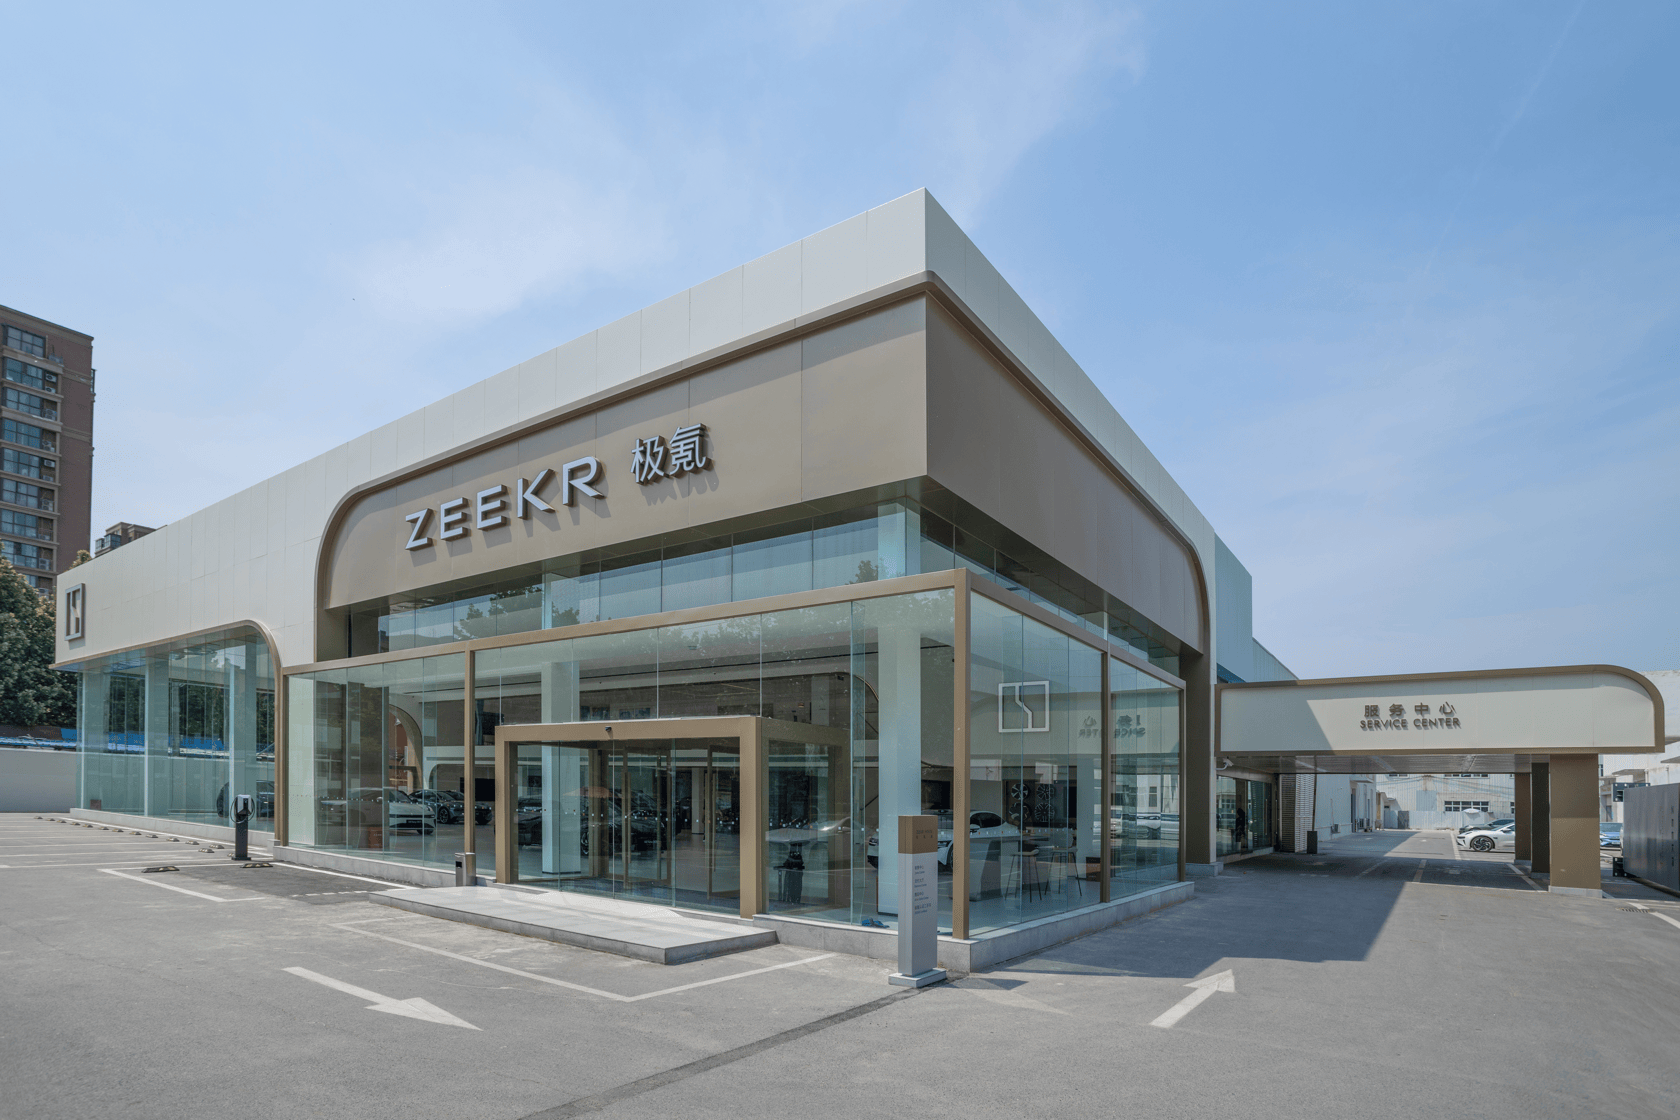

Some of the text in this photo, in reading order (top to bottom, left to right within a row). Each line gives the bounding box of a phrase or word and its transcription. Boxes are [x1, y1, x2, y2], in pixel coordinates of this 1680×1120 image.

[630, 423, 710, 485] 极氪
[405, 456, 605, 551] ZEEKR
[1360, 717, 1461, 730] SERVICE CENTER
[1364, 701, 1457, 718] 服务中心
